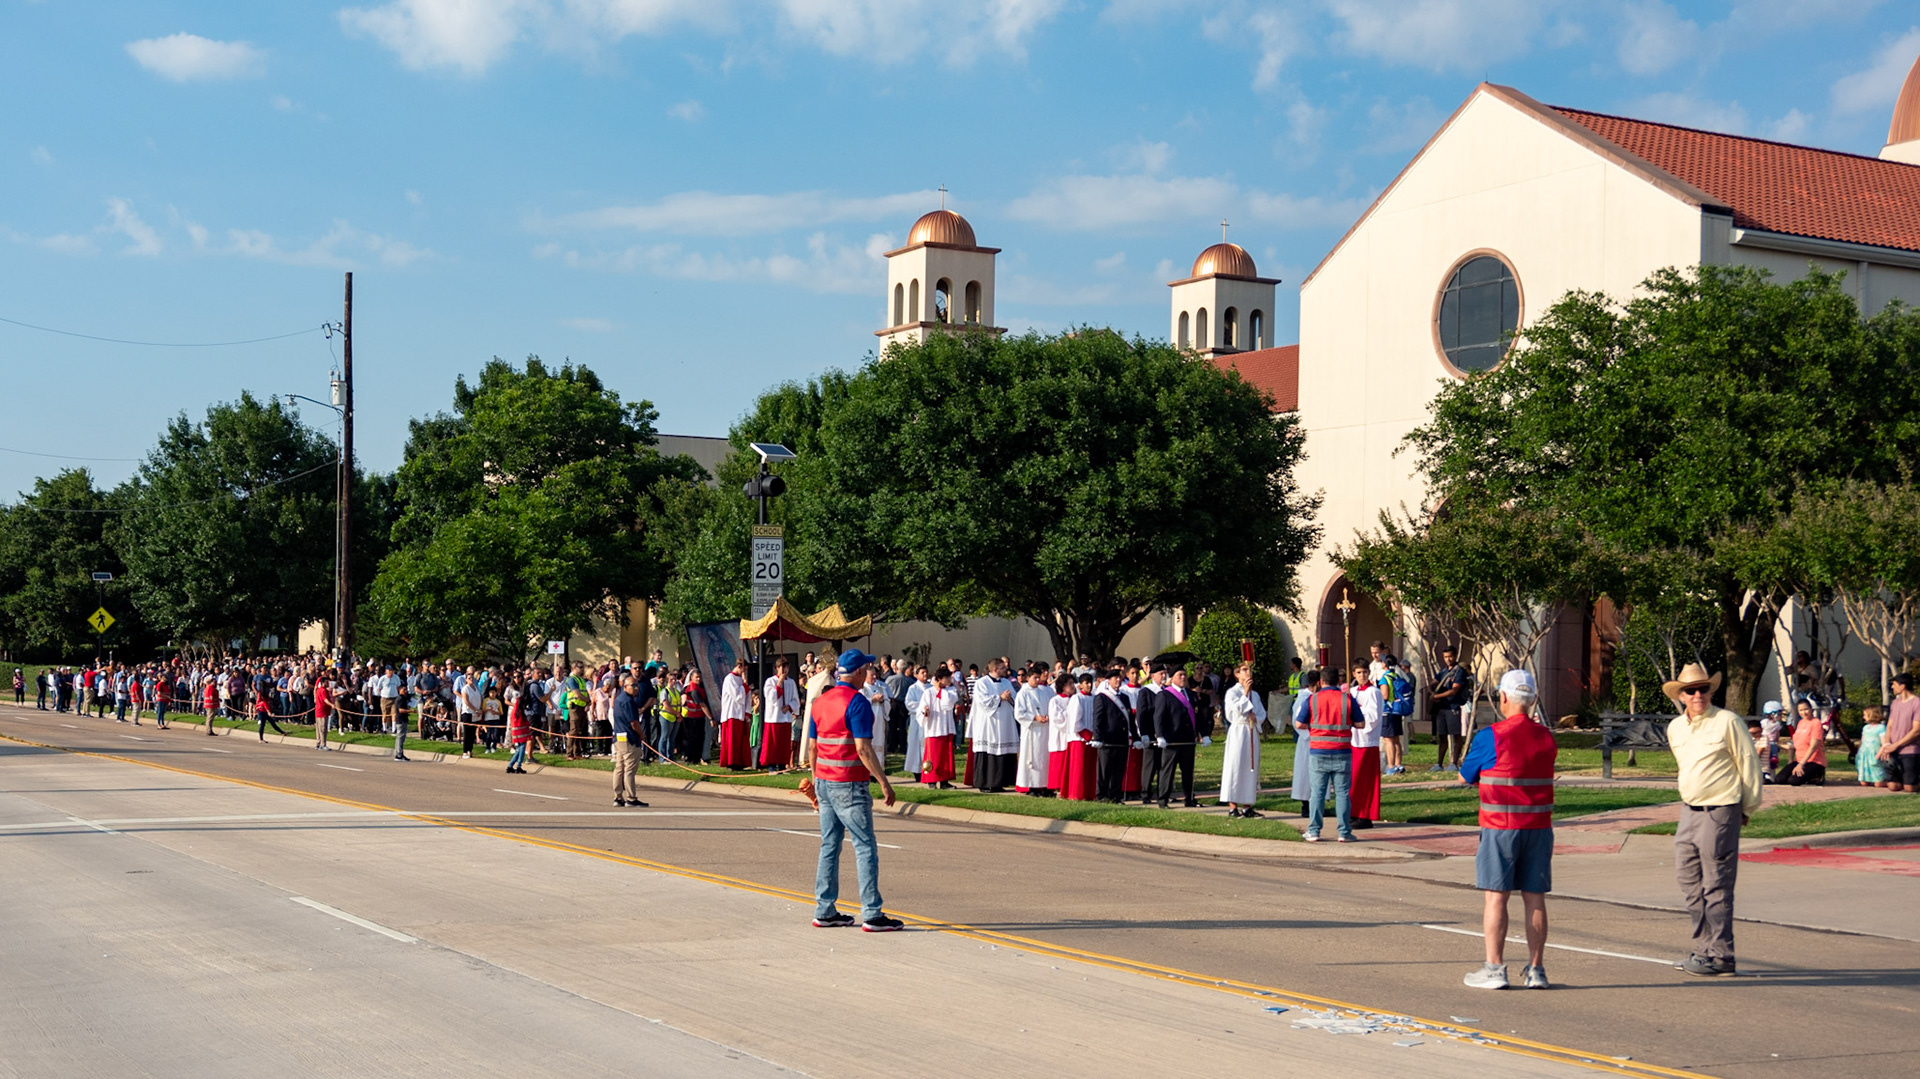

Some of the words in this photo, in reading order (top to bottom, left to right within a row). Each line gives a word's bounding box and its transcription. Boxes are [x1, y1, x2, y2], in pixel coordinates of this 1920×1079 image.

[754, 527, 782, 535] SCHOOL
[755, 543, 781, 551] SPEED
[756, 562, 780, 579] 20
